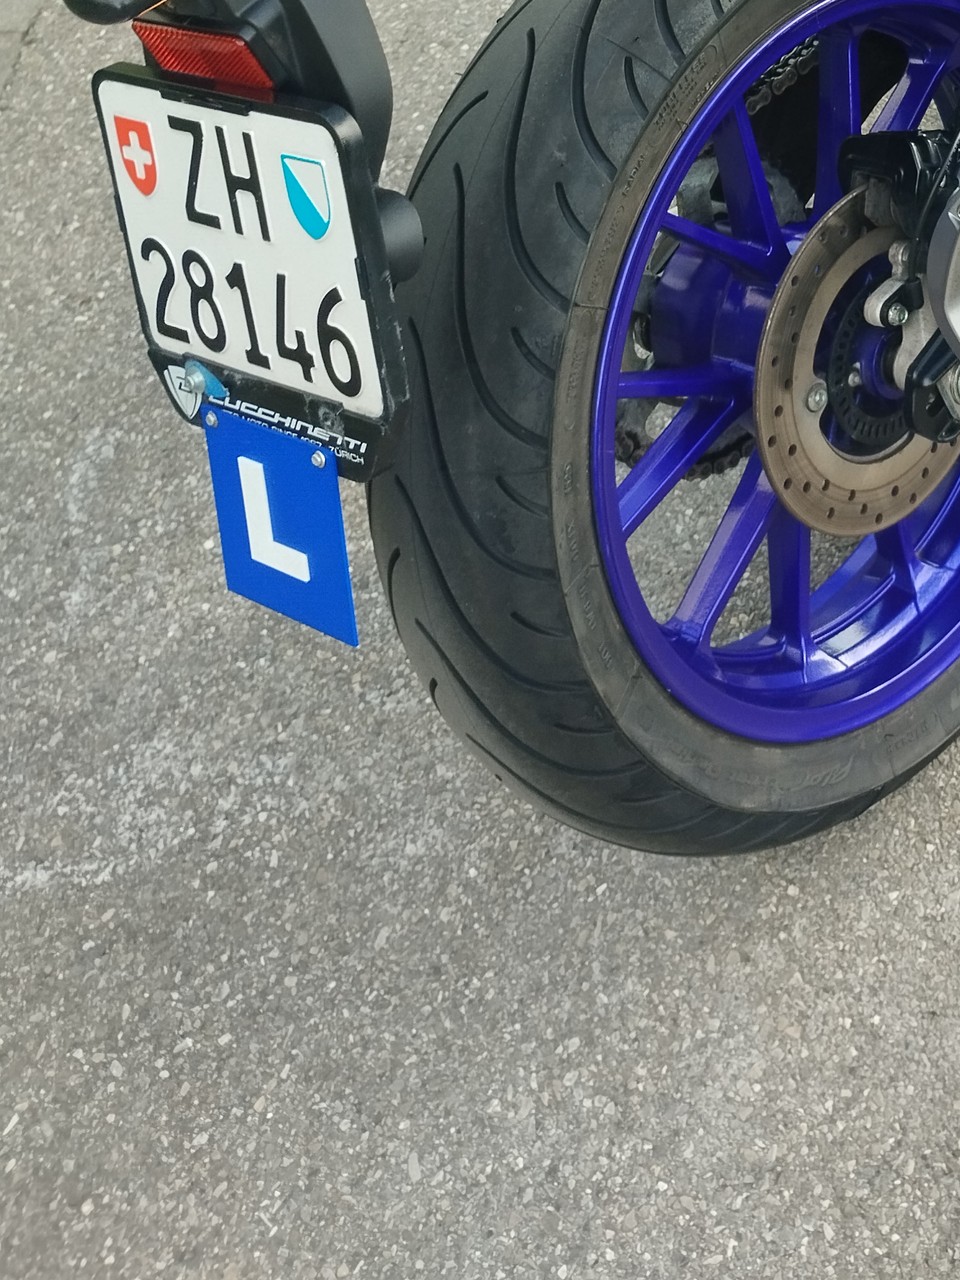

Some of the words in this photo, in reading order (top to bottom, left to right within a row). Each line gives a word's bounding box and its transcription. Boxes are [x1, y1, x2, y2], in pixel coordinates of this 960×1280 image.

[167, 114, 272, 242] ZH
[141, 237, 362, 398] 28146
[236, 455, 311, 583] L
